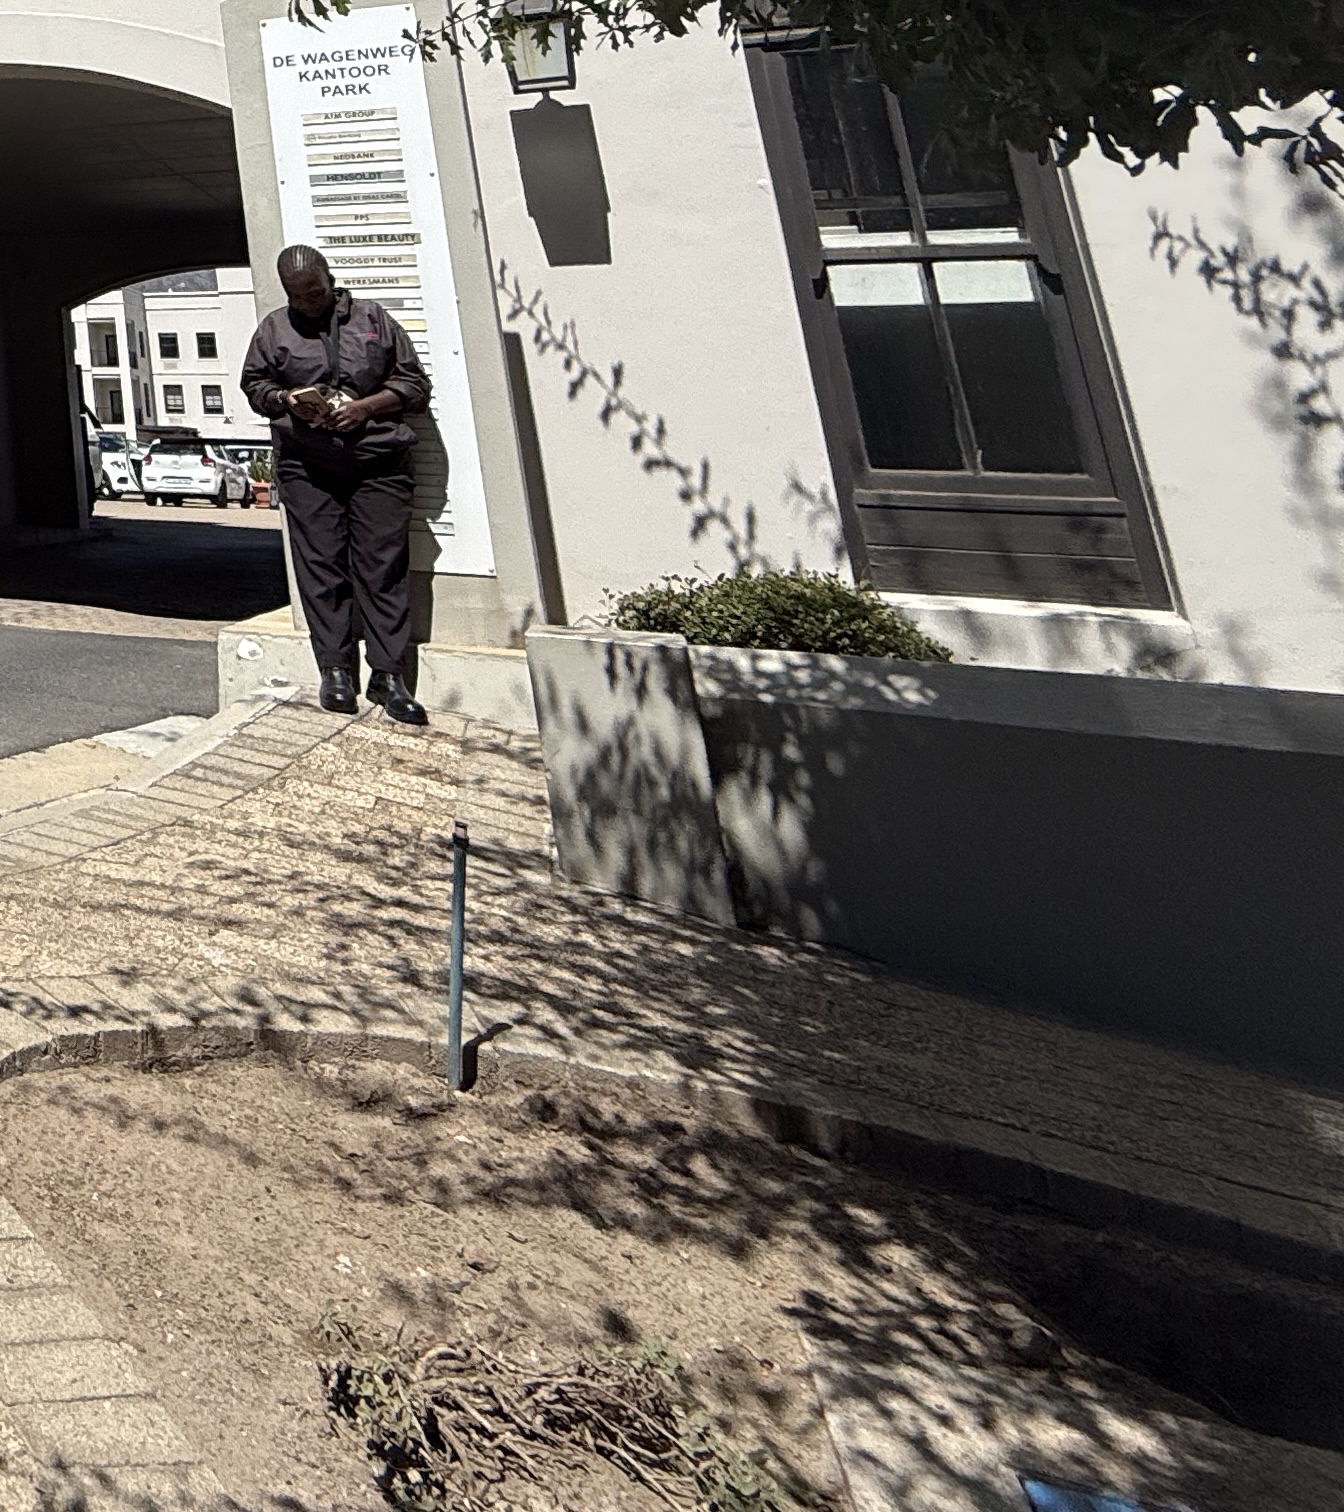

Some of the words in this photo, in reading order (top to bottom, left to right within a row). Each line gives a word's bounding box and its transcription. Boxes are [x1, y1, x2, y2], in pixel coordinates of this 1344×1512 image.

[272, 54, 297, 68] DE
[301, 44, 414, 65] WAGENWEG
[298, 64, 391, 82] KANTOOR
[321, 83, 371, 97] PARK
[324, 112, 342, 120] AIM
[344, 110, 376, 119] GROUP
[333, 152, 375, 161] NEDBANK
[326, 172, 383, 181] HENSOLDT
[328, 236, 346, 244] THE
[349, 235, 372, 243] LUXE
[376, 234, 415, 243] BEAUTY
[343, 277, 400, 285] WERKSMANS
